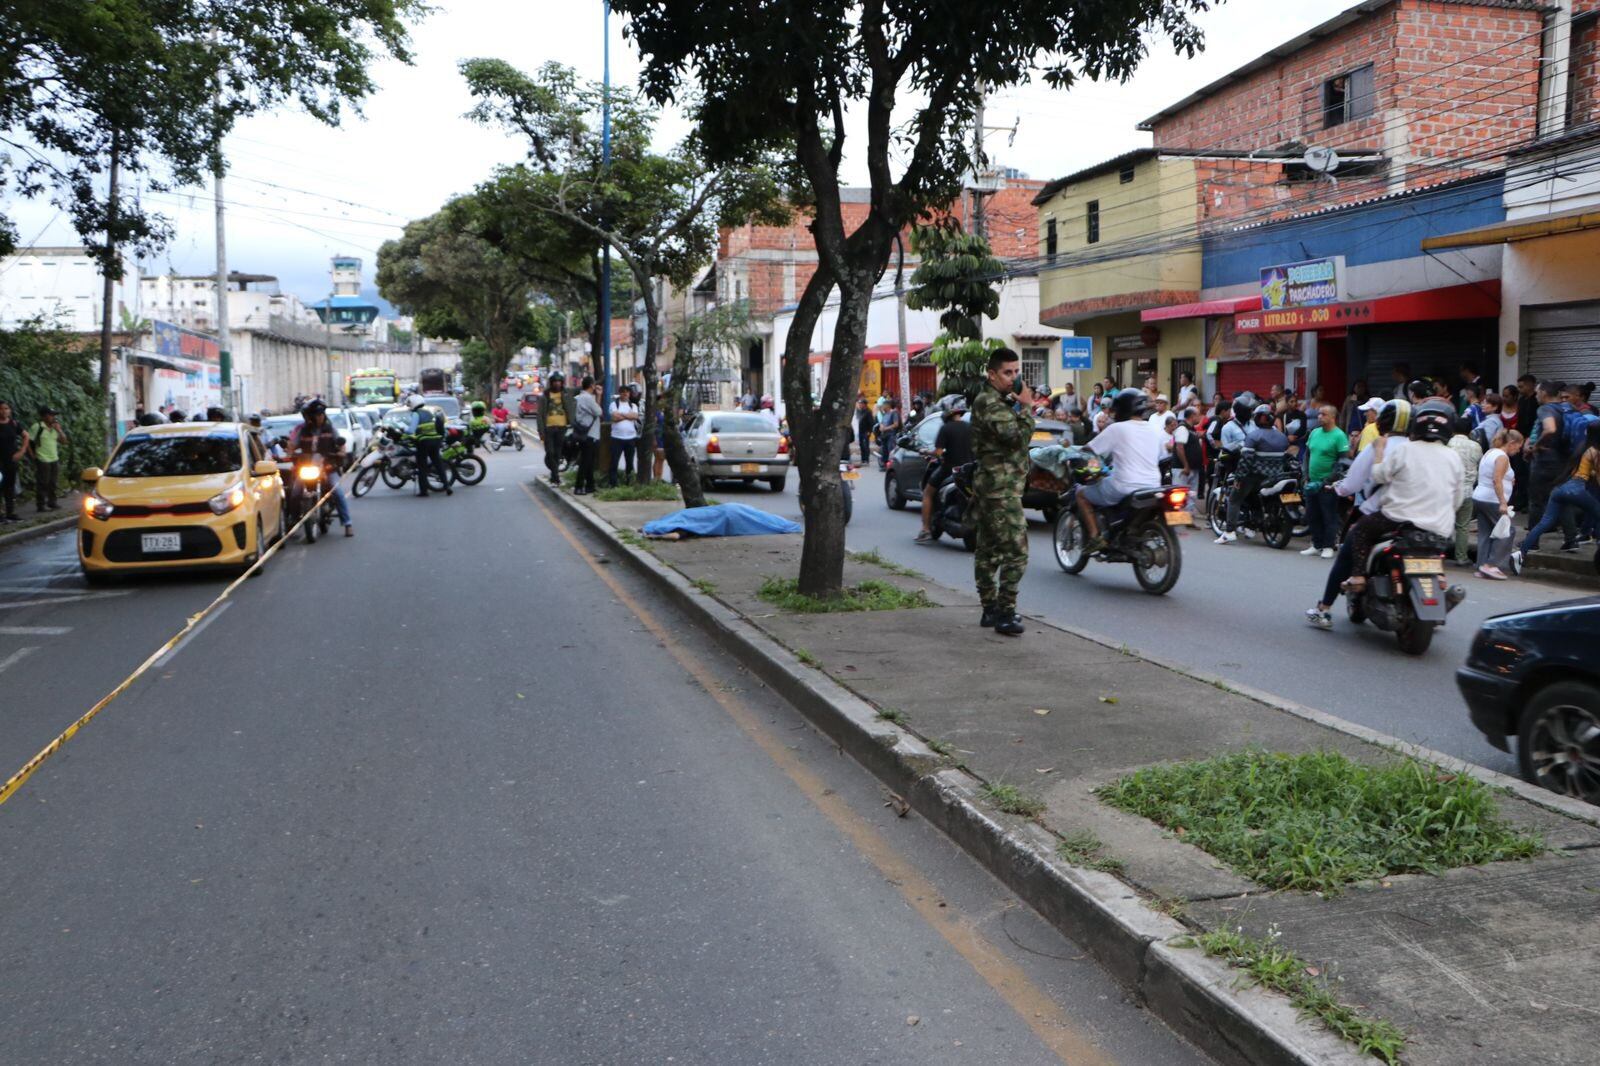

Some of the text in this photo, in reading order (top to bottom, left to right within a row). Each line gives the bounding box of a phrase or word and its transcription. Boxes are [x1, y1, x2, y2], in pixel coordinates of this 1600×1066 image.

[1289, 284, 1336, 302] PARCHADERO
[1238, 319, 1260, 328] POKER
[1264, 312, 1297, 327] LITRAZO
